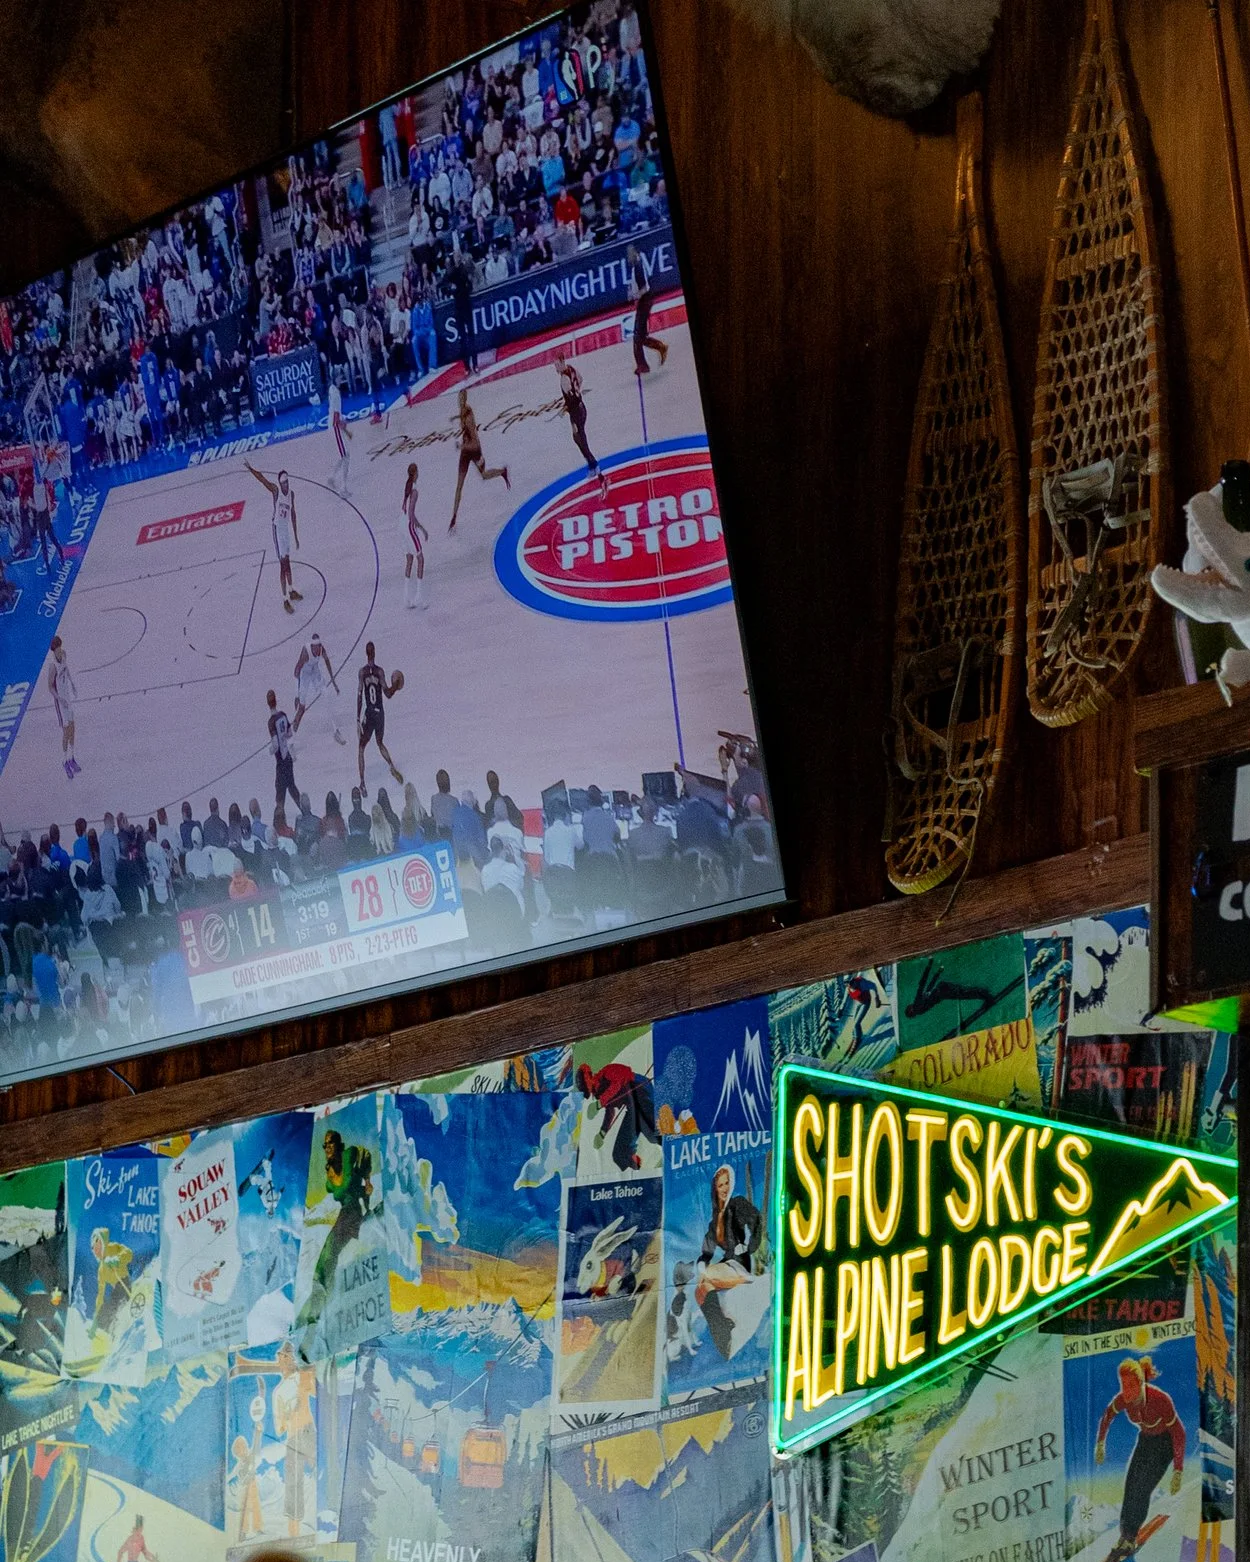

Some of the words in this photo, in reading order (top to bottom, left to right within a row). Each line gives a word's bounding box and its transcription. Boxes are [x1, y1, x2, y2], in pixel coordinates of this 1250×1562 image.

[256, 359, 314, 392] SATURDAY
[202, 431, 273, 464] PLAYOFFS
[66, 490, 101, 546] ULTRA
[145, 506, 236, 541] Emirates
[434, 848, 458, 904] DET
[298, 900, 330, 925] 3:19
[350, 874, 384, 922] 28
[407, 872, 429, 895] DET
[181, 918, 200, 969] CLE
[247, 903, 277, 949] 14
[1070, 1042, 1132, 1067] WINTER
[1067, 1065, 1169, 1094] SPORT
[670, 1134, 712, 1170] LAKE
[83, 1160, 112, 1211] Ski
[177, 1158, 226, 1205] SQUAW
[590, 1187, 614, 1202] Lake
[615, 1184, 644, 1201] Tahoe
[788, 1092, 1093, 1258] SHOTSKI'S
[127, 1185, 158, 1208] LAKE
[176, 1182, 233, 1231] VALLEY
[121, 1211, 160, 1236] TAHOE
[343, 1255, 381, 1292] LAKE
[783, 1246, 929, 1421] ALPINE
[937, 1221, 1092, 1346] LODGE
[1104, 1299, 1185, 1322] TAHOE
[1063, 1342, 1080, 1358] SKI
[1080, 1340, 1091, 1354] IN
[1093, 1336, 1112, 1351] THE
[1113, 1333, 1133, 1349] SUN
[1151, 1321, 1183, 1340] WINTER
[1, 1428, 19, 1451] LAKE
[40, 1404, 75, 1433] NIGHTLIFE
[938, 1431, 1062, 1494] WINTER
[951, 1480, 1054, 1535] SPORT
